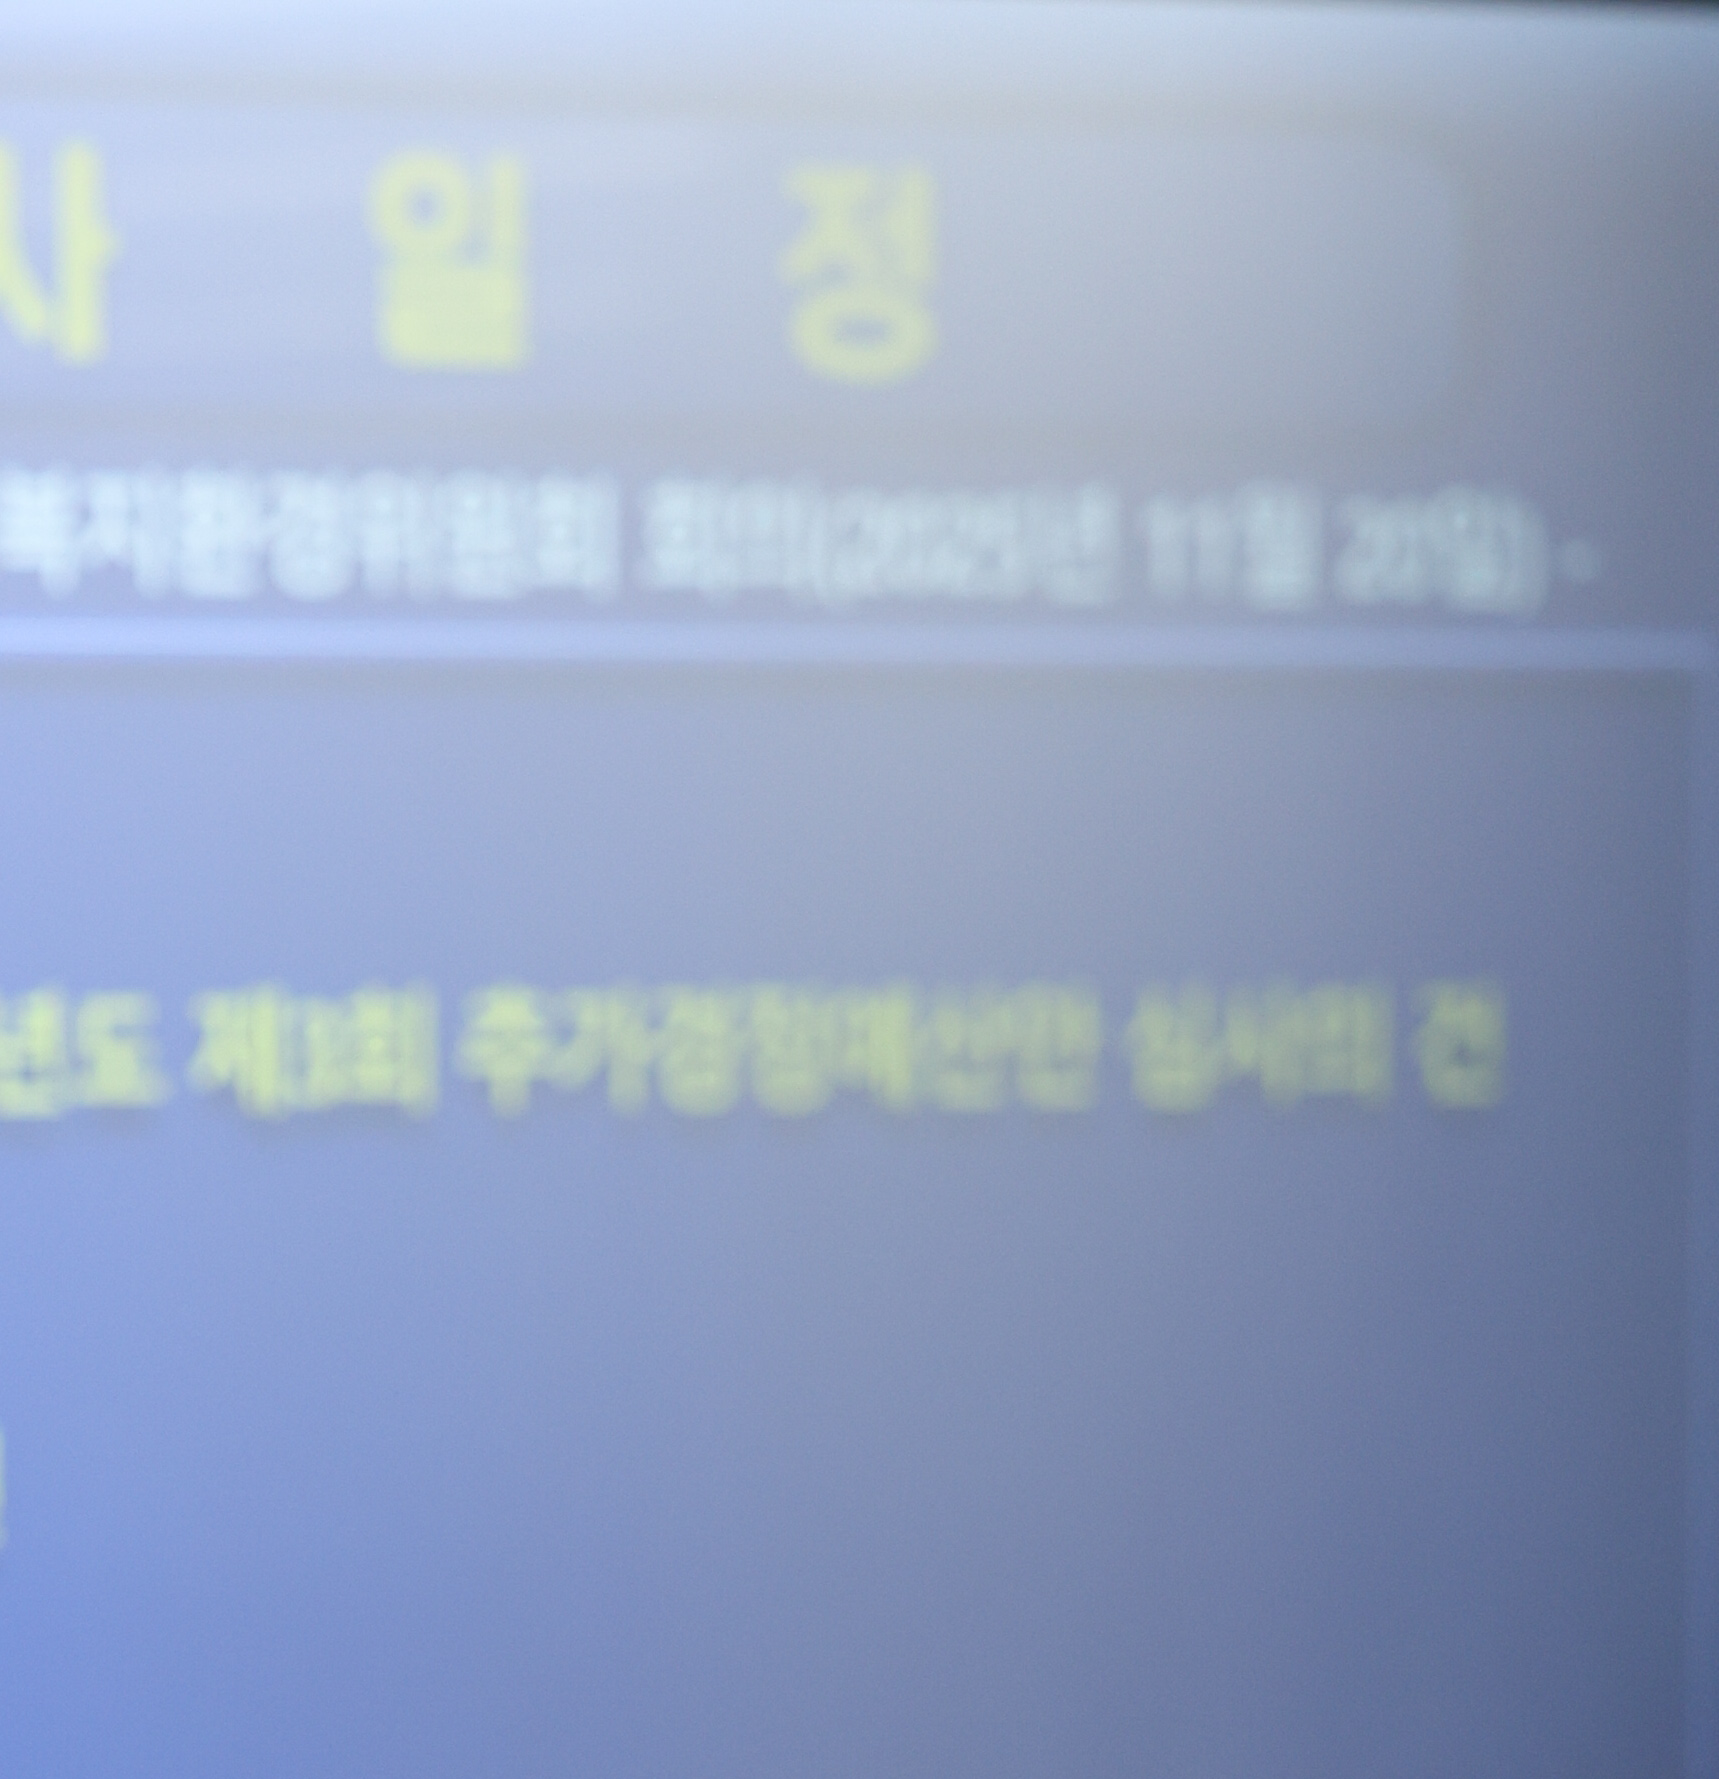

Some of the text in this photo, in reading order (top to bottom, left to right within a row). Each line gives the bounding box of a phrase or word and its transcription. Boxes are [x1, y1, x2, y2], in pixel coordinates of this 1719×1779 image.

[1143, 482, 1315, 606] 11월
[458, 984, 1095, 1116] 추가경정예산안
[1129, 982, 1390, 1113] 심사의
[1418, 982, 1500, 1110] 건
